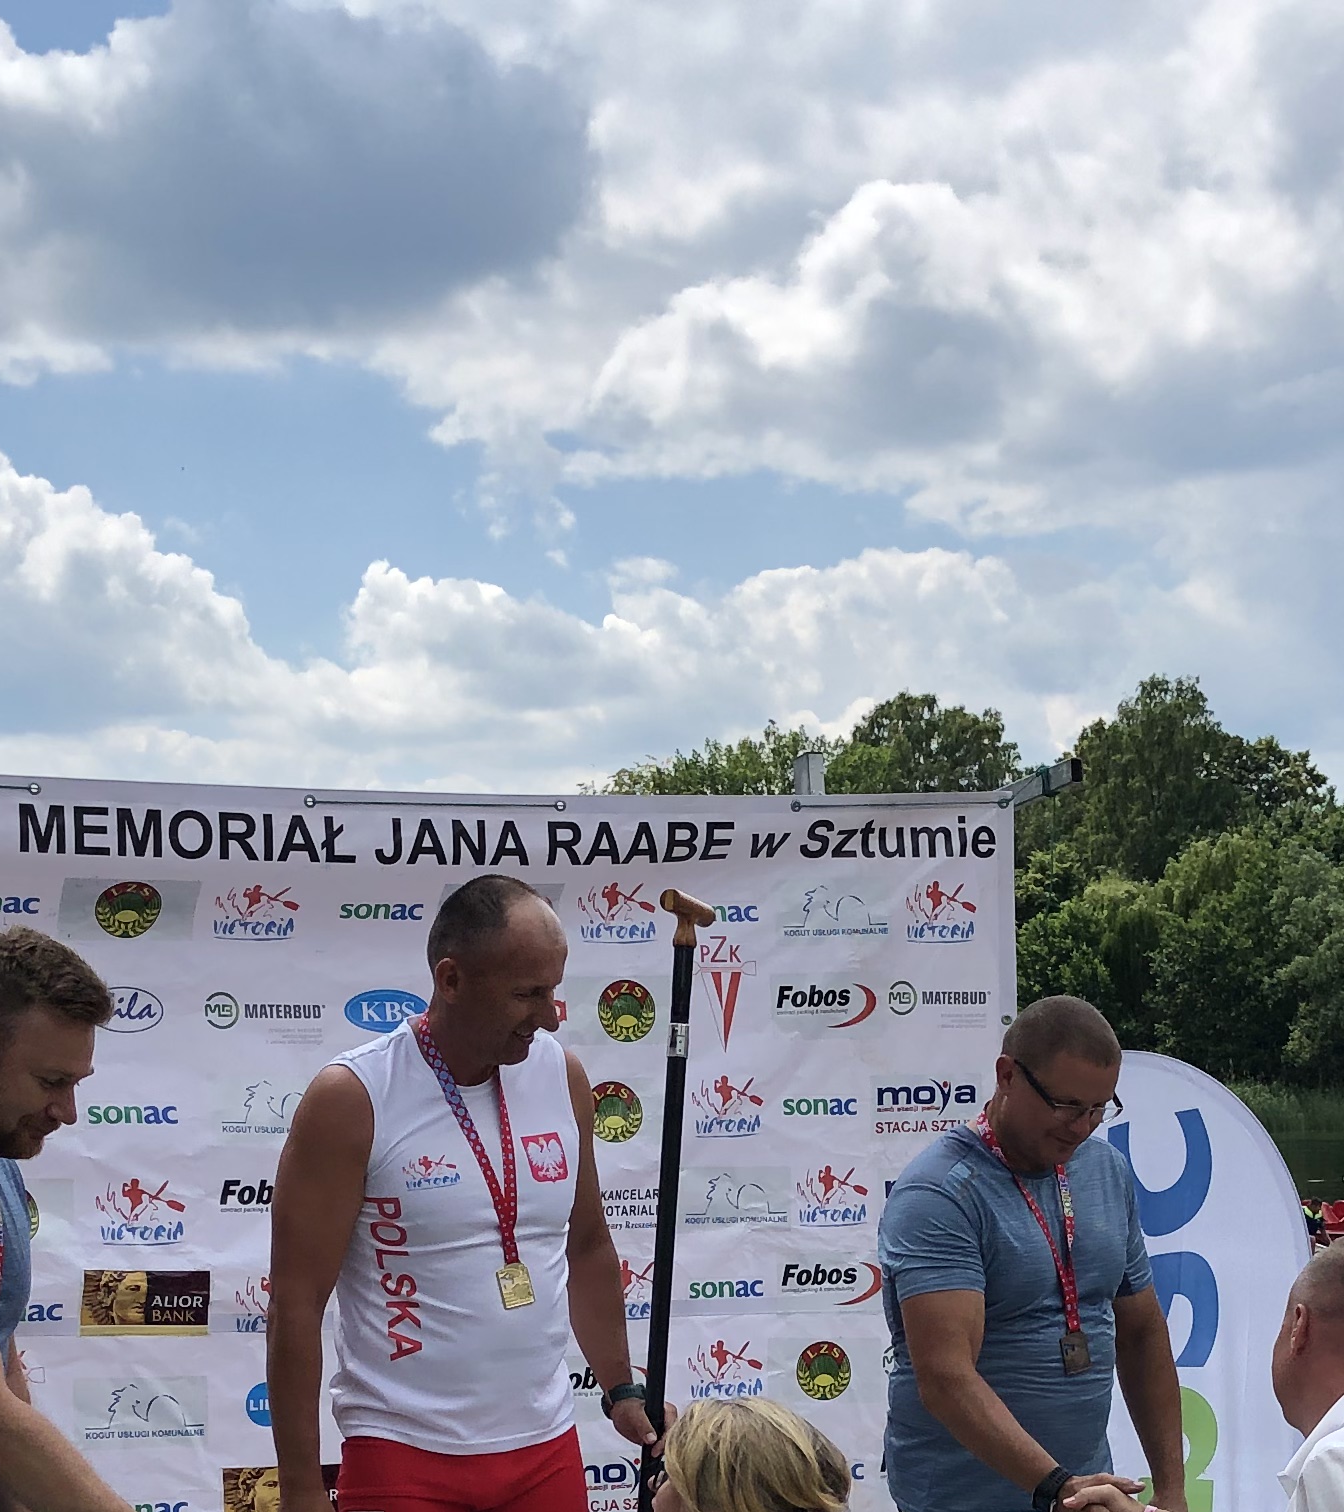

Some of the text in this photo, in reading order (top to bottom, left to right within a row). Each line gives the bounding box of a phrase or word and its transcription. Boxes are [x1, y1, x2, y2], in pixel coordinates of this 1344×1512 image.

[18, 803, 356, 864] MEMORIAŁ
[375, 818, 530, 866] JANA
[547, 821, 735, 866] RAABE
[750, 833, 791, 858] w
[799, 816, 996, 859] Sztumie
[109, 883, 154, 899] LZS
[339, 903, 424, 921] sonac
[713, 904, 759, 923] nac
[700, 936, 741, 963] PZK
[607, 982, 645, 1001] LZS
[776, 984, 851, 1008] Fobos
[922, 991, 987, 1005] MATERBUD
[244, 1003, 323, 1019] MATERBUD
[593, 1084, 629, 1099] LZS
[877, 1078, 976, 1117] moya
[87, 1104, 179, 1125] sonac
[783, 1098, 857, 1116] sonac
[222, 1125, 252, 1134] KOGUT
[875, 1119, 970, 1134] STACJA SZT
[220, 1179, 273, 1205] Fob
[601, 1189, 659, 1201] KANCELAR
[604, 1205, 658, 1216] OTARIAL
[364, 1196, 423, 1361] POLSKA
[781, 1263, 857, 1288] Fobos
[689, 1279, 763, 1299] sonac
[151, 1296, 204, 1309] ALIOR
[151, 1310, 196, 1323] BANK
[807, 1343, 839, 1358] LZS
[588, 1499, 619, 1512] CJA
